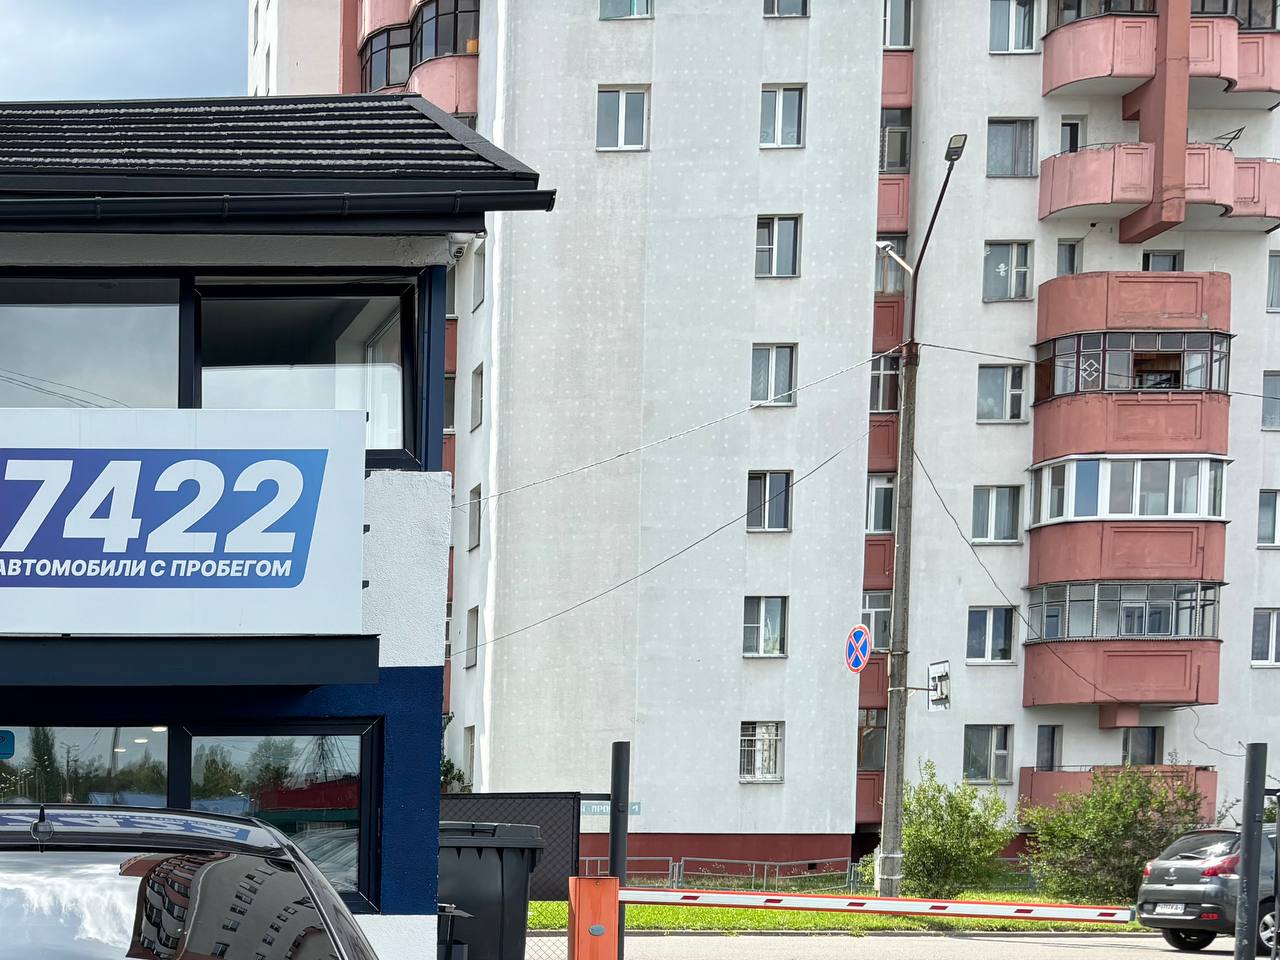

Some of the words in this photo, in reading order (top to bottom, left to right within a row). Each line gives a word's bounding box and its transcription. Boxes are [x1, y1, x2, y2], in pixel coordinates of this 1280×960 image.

[0, 458, 304, 553] 7422
[150, 559, 166, 577] С
[170, 560, 292, 577] ПРОБЕГОМ
